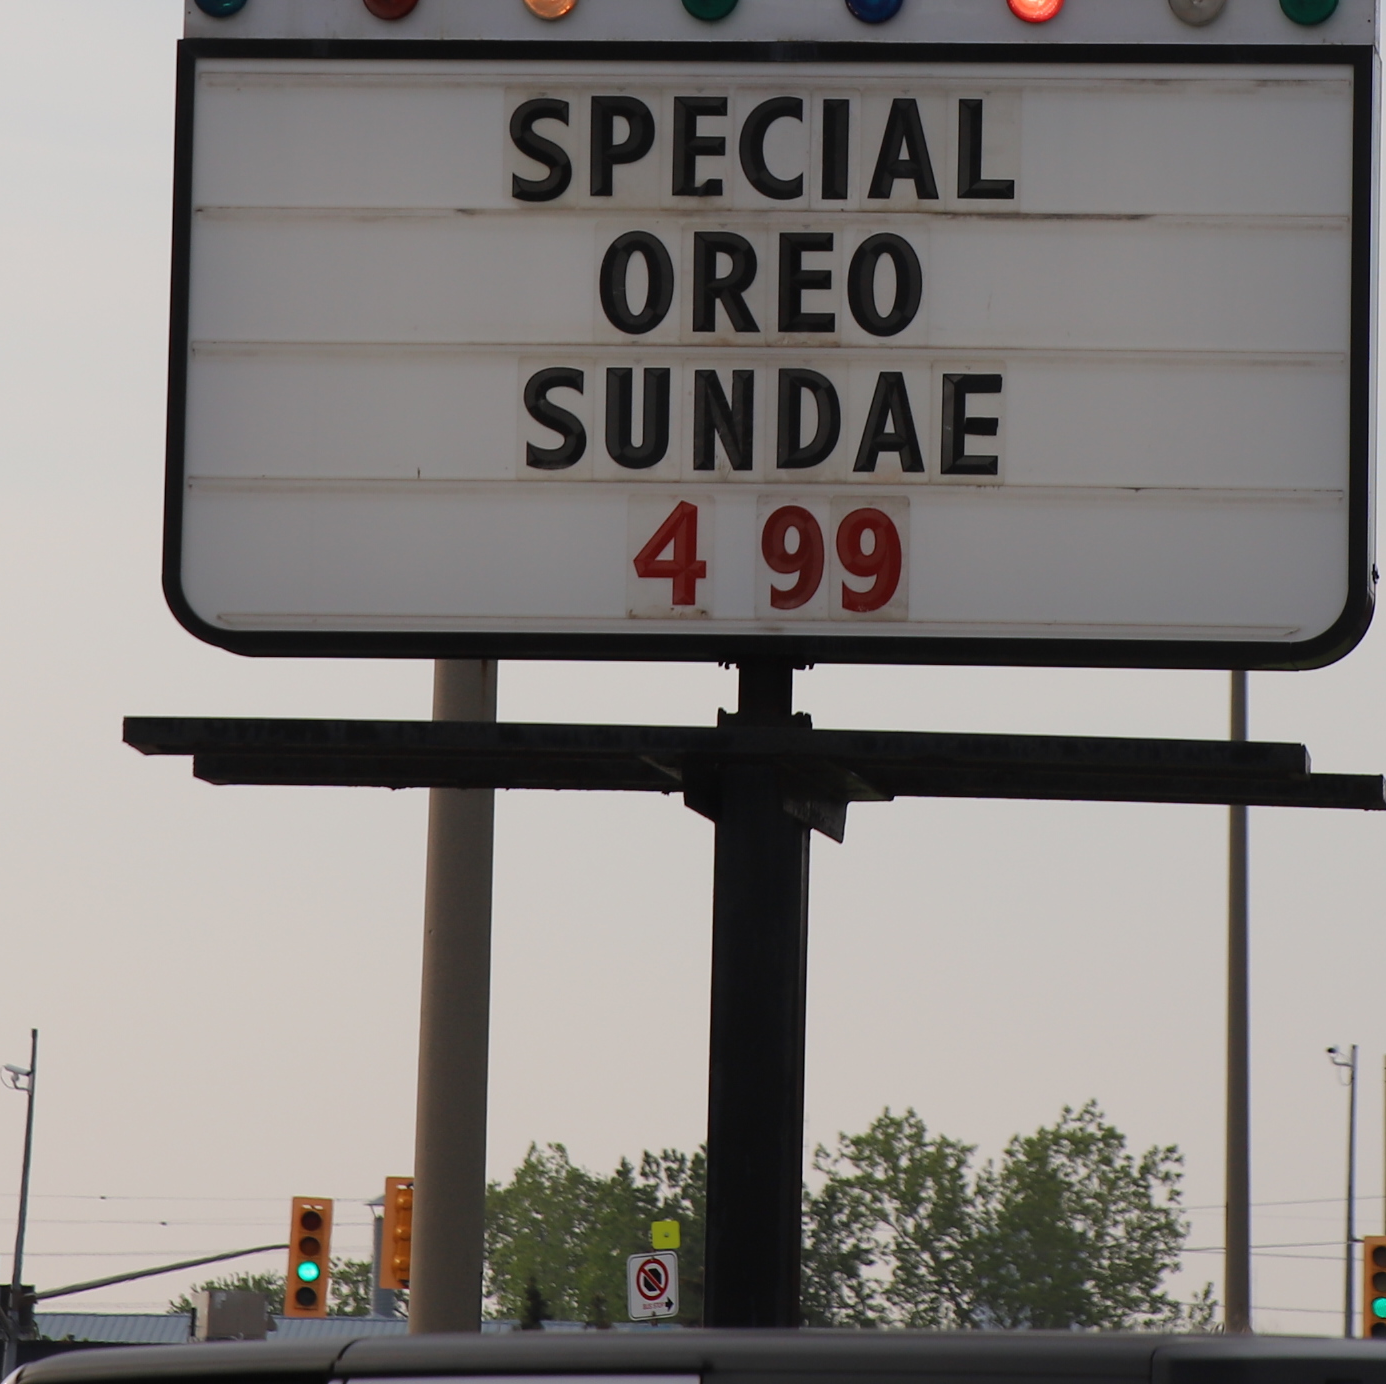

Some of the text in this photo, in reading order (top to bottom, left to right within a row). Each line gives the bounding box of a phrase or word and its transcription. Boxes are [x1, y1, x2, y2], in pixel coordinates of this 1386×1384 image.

[509, 95, 1015, 202] SPECIAL
[599, 230, 923, 337] OREO
[523, 366, 1003, 475] SUNDAE
[633, 500, 902, 612] 4 99
